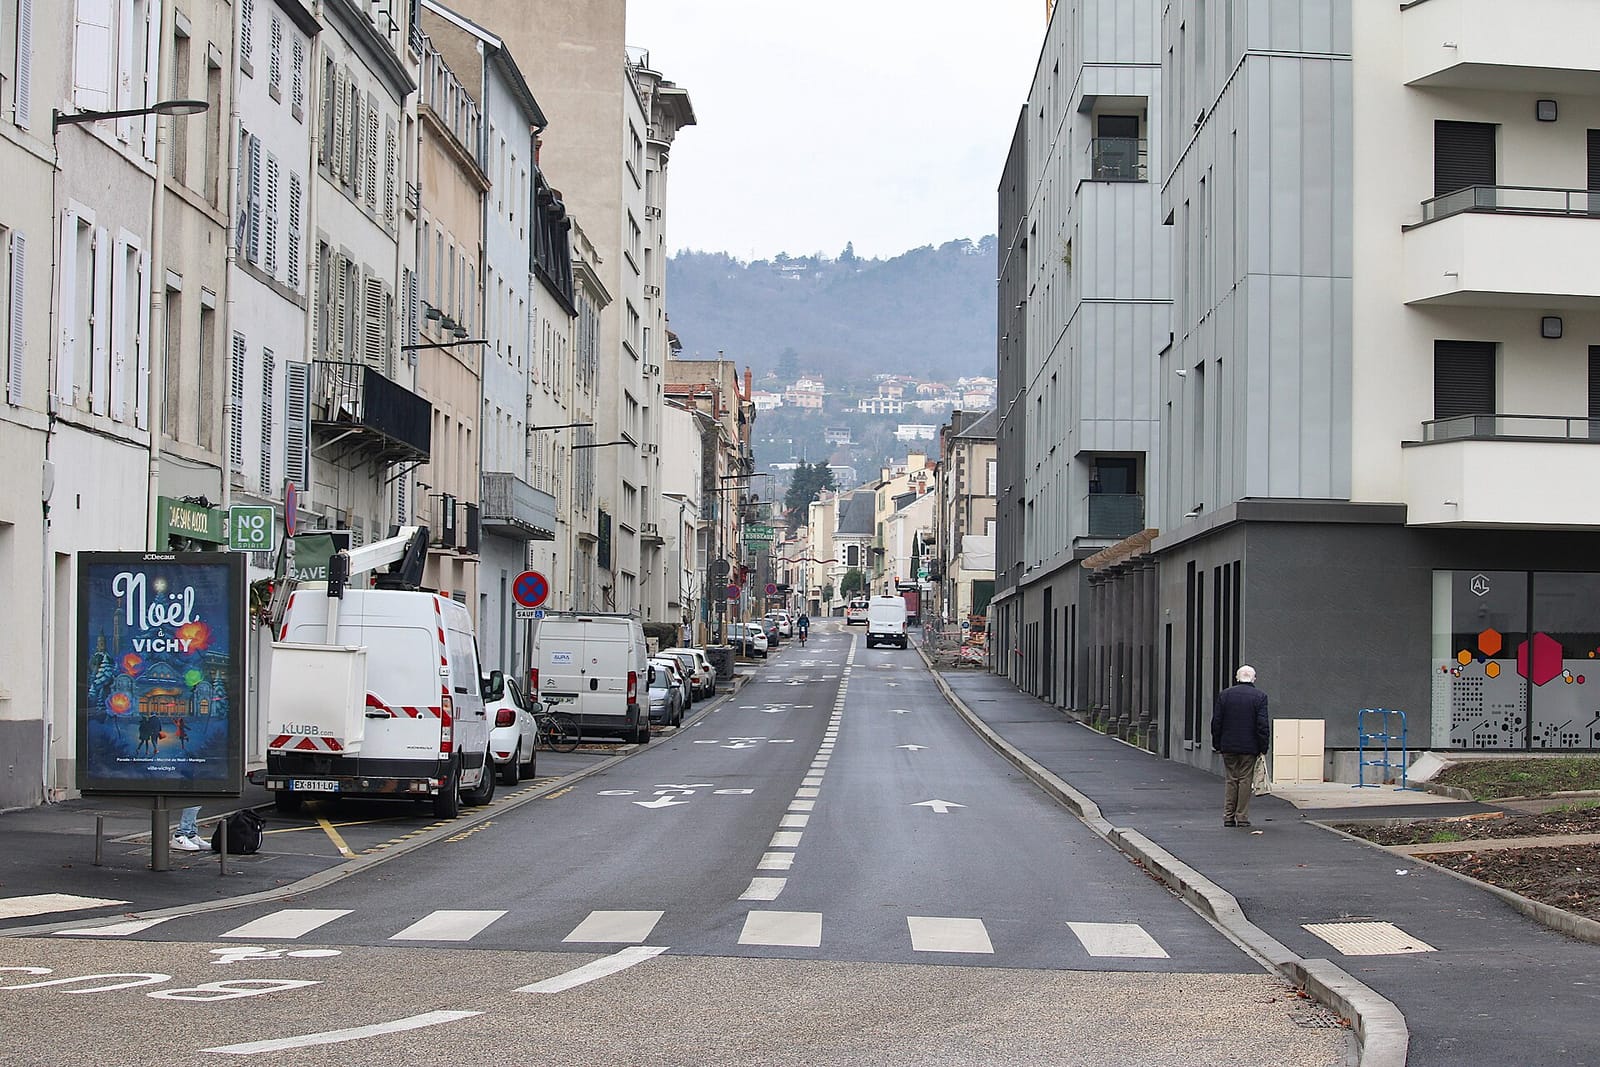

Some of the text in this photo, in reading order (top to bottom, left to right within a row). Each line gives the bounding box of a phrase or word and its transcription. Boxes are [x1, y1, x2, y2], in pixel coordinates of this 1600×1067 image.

[238, 515, 265, 529] NO
[238, 529, 265, 542] LO
[112, 572, 200, 630] Noël
[158, 628, 165, 637] à
[132, 638, 192, 652] VICHY
